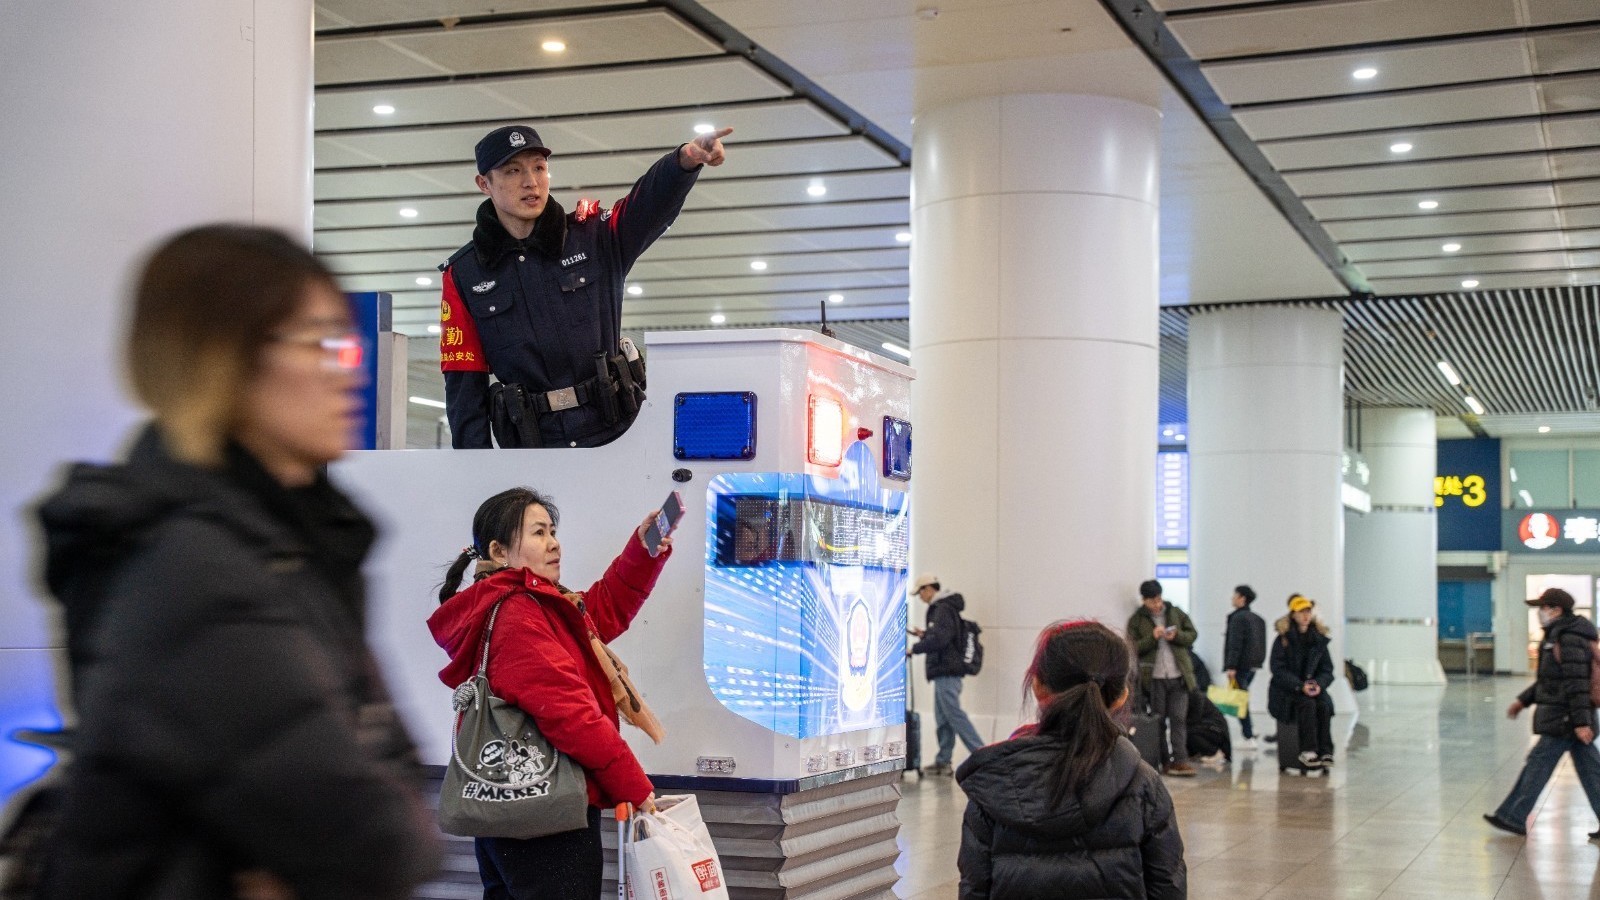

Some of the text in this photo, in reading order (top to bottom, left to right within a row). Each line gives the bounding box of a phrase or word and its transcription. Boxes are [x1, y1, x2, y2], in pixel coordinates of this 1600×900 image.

[561, 252, 587, 266] 011261
[440, 351, 475, 362] 公安处
[462, 780, 551, 802] #MICKEY
